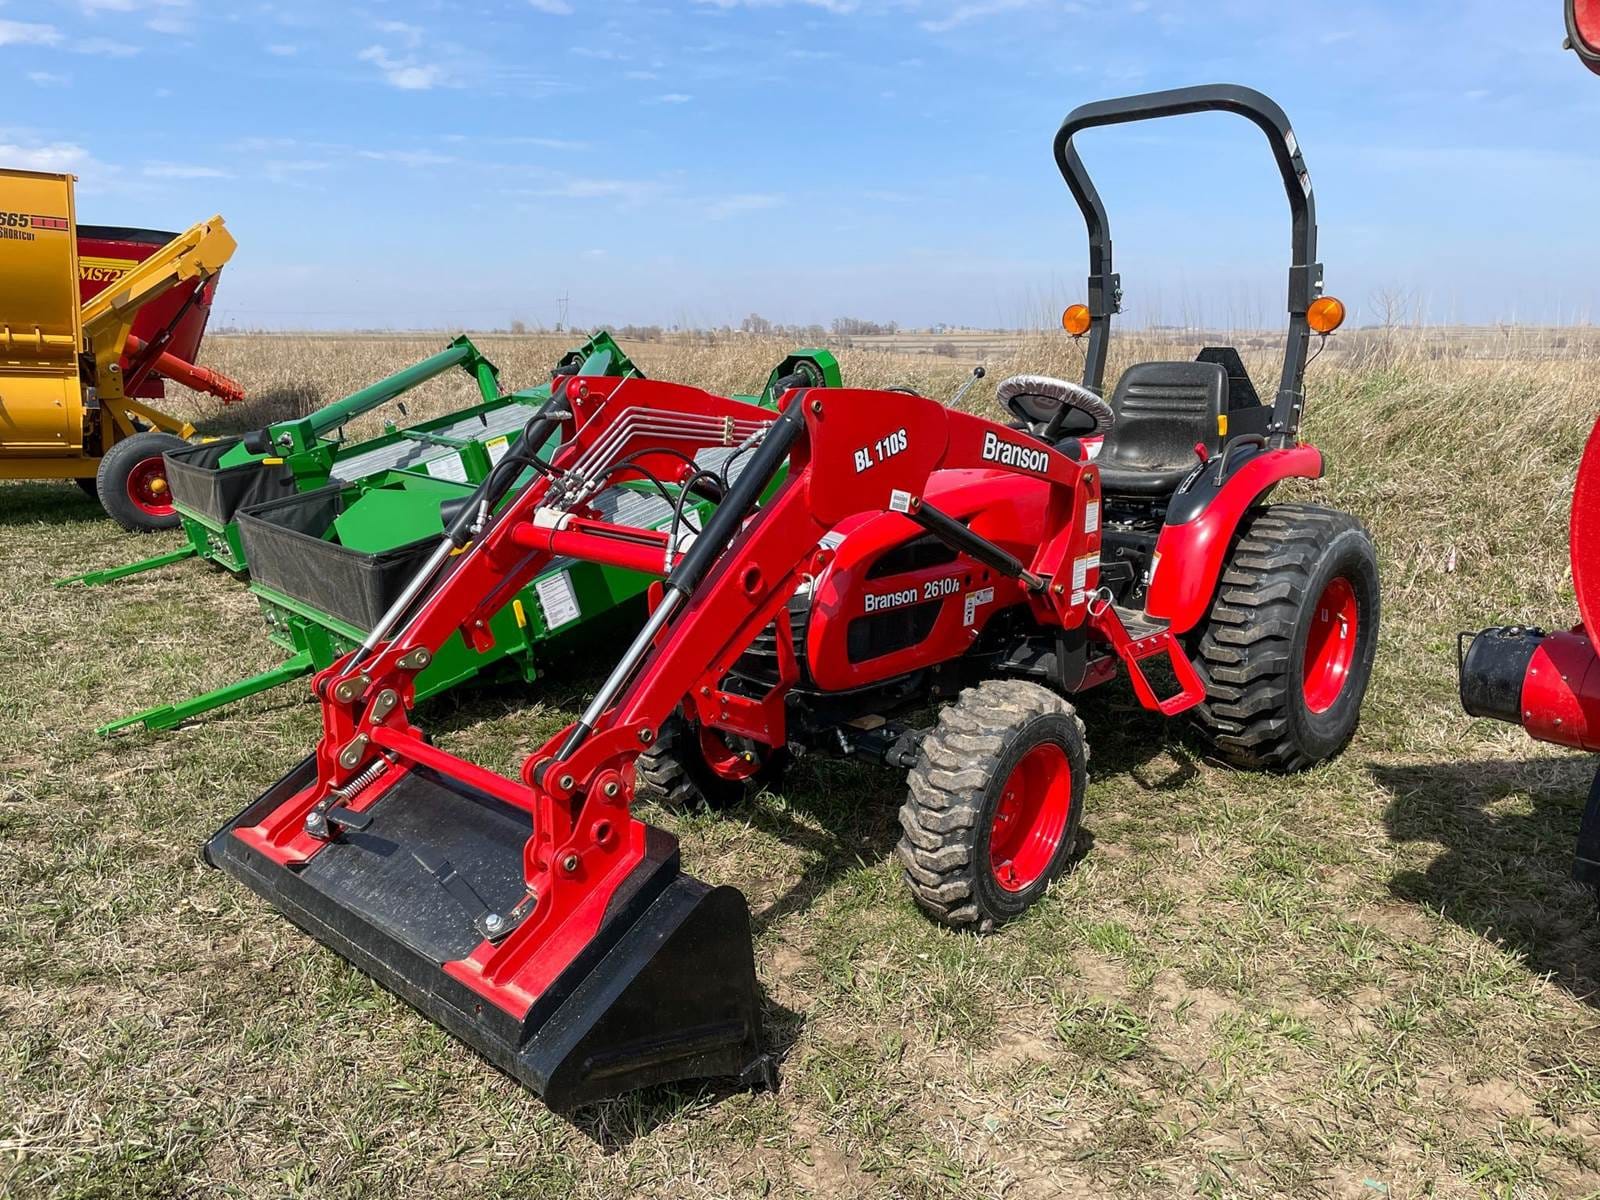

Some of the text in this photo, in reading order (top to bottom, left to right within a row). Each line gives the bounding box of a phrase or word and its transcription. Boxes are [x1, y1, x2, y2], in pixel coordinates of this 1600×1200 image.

[854, 428, 908, 473] BL 110S
[982, 431, 1050, 473] Branson
[864, 589, 918, 612] Branson
[923, 578, 960, 599] 2610h
